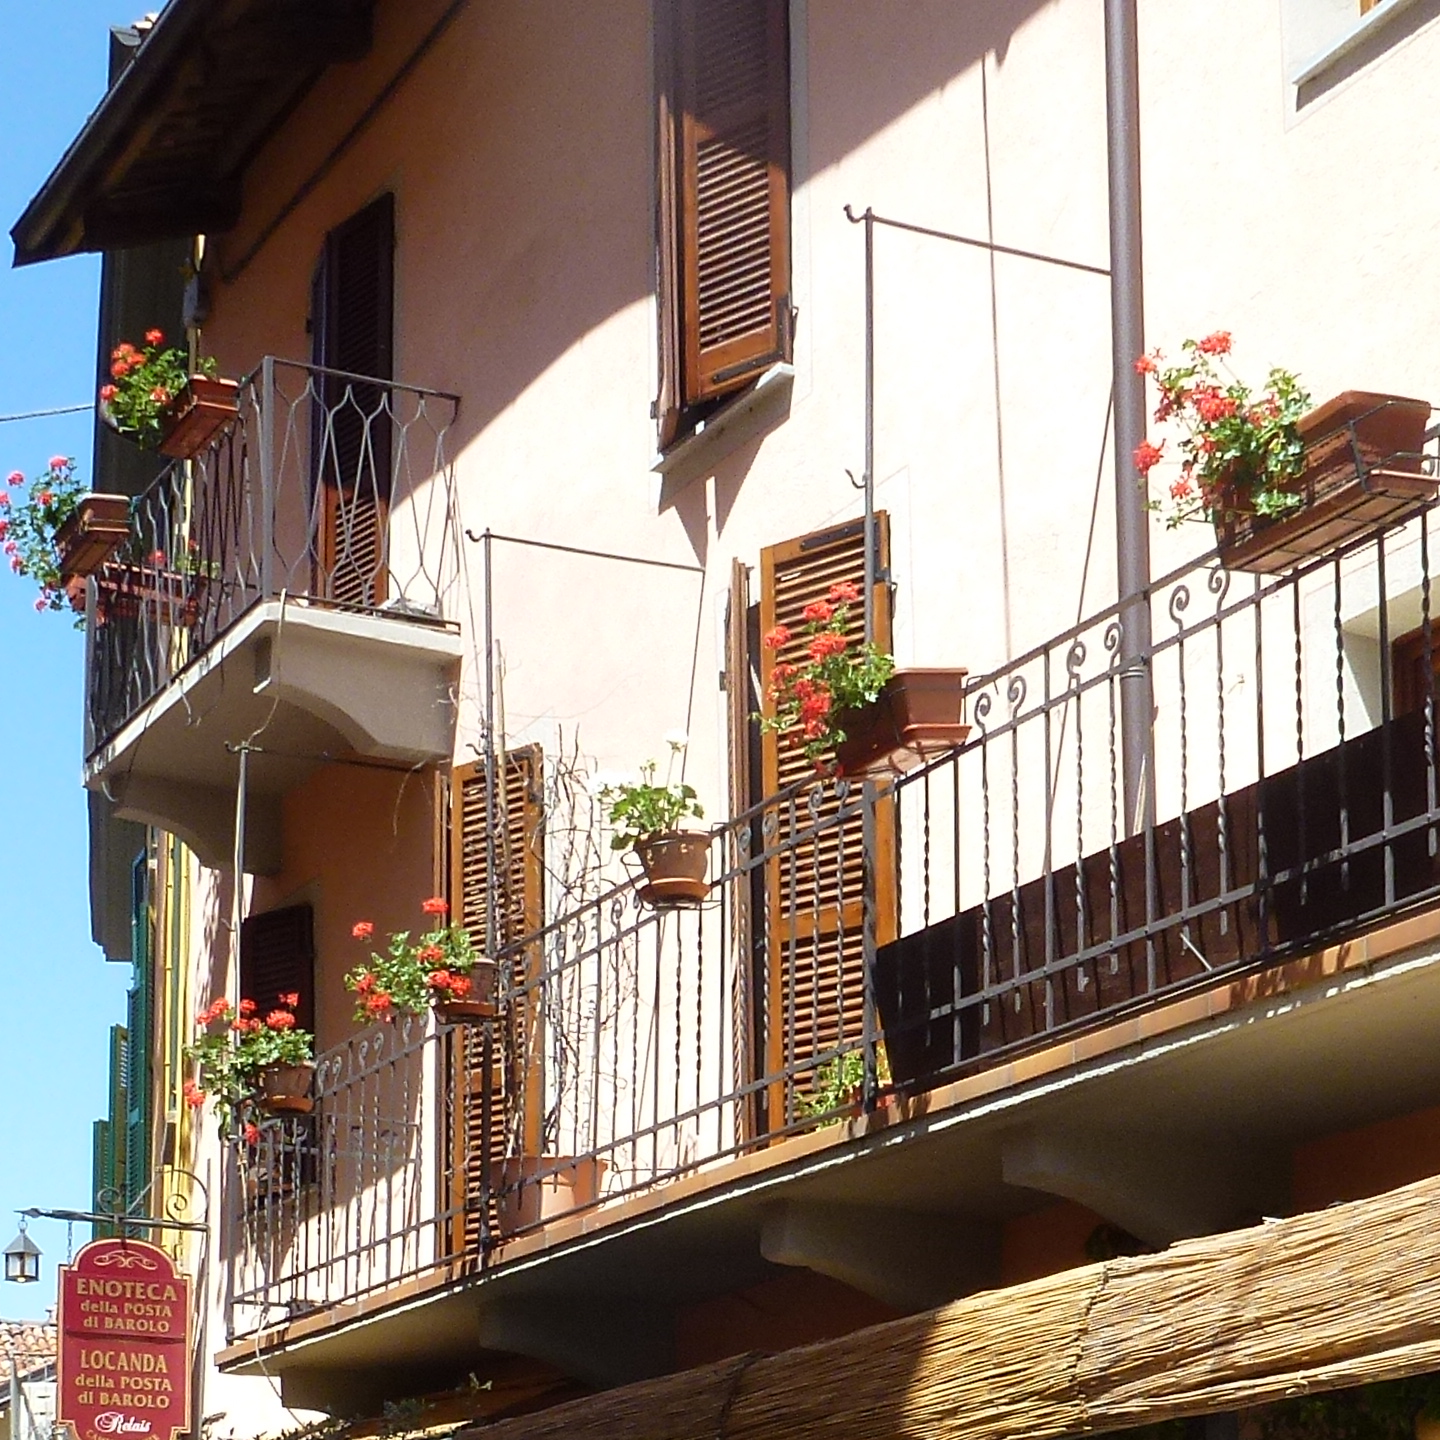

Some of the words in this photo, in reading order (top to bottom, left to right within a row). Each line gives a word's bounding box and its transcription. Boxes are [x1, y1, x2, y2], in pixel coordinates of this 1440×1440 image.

[76, 1278, 178, 1302] ENOTECA
[80, 1299, 119, 1315] della
[123, 1303, 173, 1318] POSTA
[83, 1316, 99, 1329] di
[103, 1317, 170, 1333] BAROLO
[79, 1349, 168, 1374] LOCANDA
[74, 1373, 115, 1389] della
[120, 1376, 173, 1392] POSTA
[77, 1390, 94, 1405] di
[99, 1392, 170, 1409] BAROLO
[94, 1411, 152, 1435] Relais
